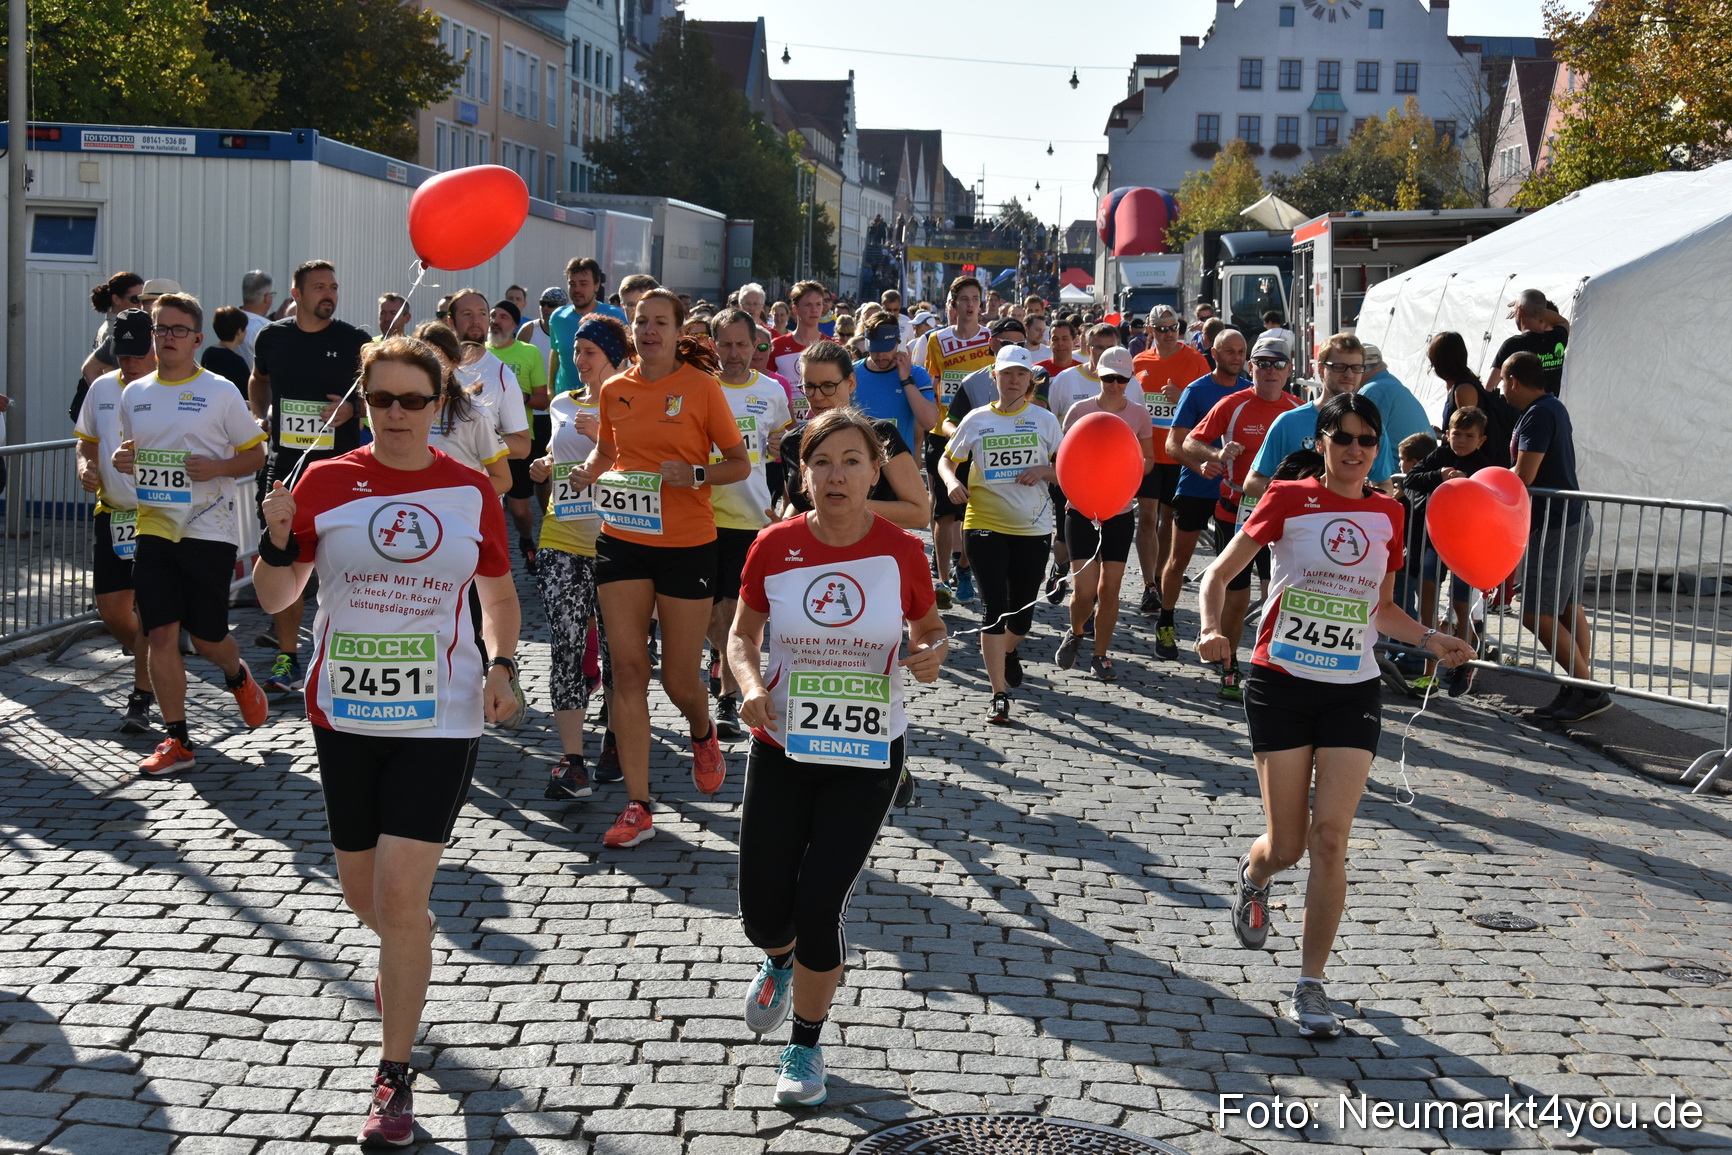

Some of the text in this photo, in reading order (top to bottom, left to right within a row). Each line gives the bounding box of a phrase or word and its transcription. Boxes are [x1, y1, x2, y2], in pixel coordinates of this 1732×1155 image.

[944, 252, 981, 262] START
[944, 356, 966, 368] MAX
[944, 372, 966, 380] BOC
[986, 435, 1034, 448] BOCK
[137, 451, 186, 465] BOCK
[989, 450, 1033, 467] 2657
[139, 468, 185, 488] 2218
[601, 473, 656, 490] CK
[994, 470, 1023, 478] ANDRE
[148, 492, 172, 500] LUCA
[601, 489, 651, 513] 2611
[561, 504, 592, 514] MARTI
[604, 513, 651, 527] BARBARA
[344, 572, 454, 592] LAUFEN MIT HERZ
[1317, 580, 1332, 588] Heck
[1338, 574, 1355, 583] MIT
[1358, 576, 1378, 590] HERZ
[364, 588, 386, 597] Heck
[395, 592, 408, 601] Dr.
[410, 593, 441, 605] Röschl
[350, 599, 435, 616] Leistungsdiagnostik
[1287, 590, 1362, 621] BOCK
[1285, 616, 1354, 650] 2454
[336, 637, 426, 658] BOCK
[780, 634, 884, 651] LAUFEN MIT HERZ
[842, 649, 870, 657] Röschl
[1295, 650, 1338, 667] DORIS
[791, 657, 867, 668] eistungsdiagnostik
[340, 666, 420, 696] 2451
[797, 675, 884, 699] BOCK
[347, 704, 418, 718] RICARDA
[800, 702, 880, 735] 2458
[809, 739, 869, 756] RENATE
